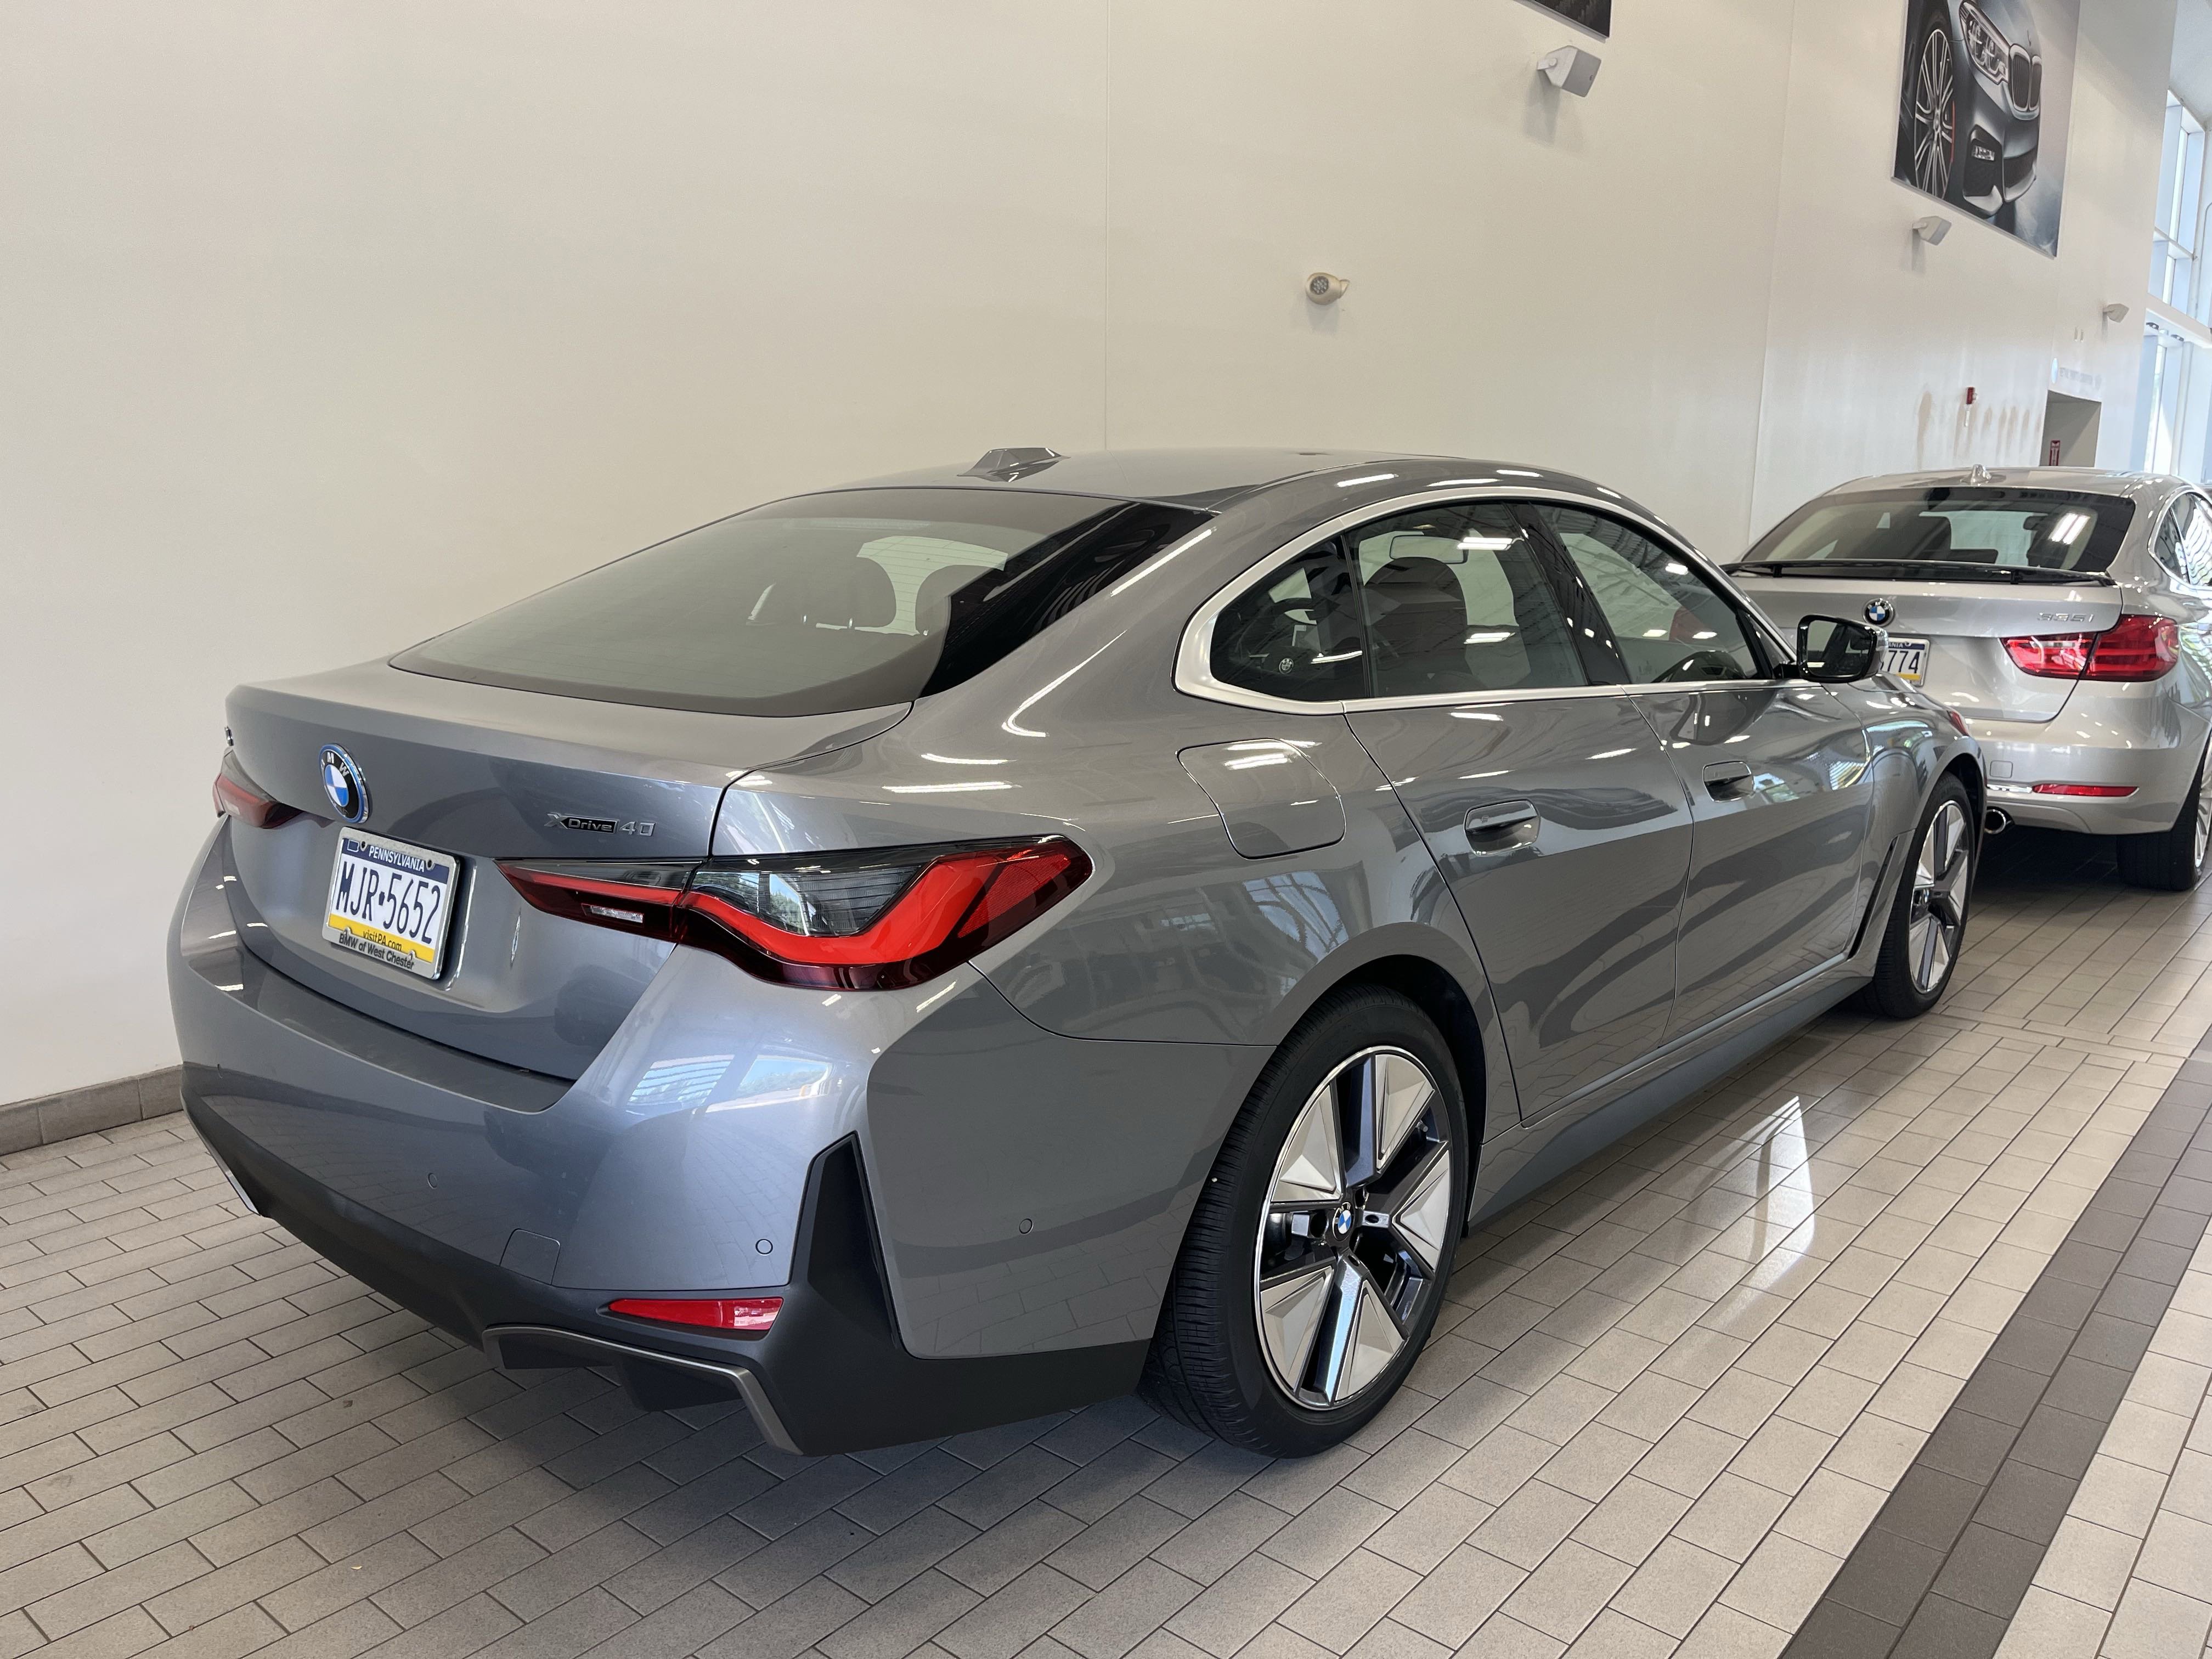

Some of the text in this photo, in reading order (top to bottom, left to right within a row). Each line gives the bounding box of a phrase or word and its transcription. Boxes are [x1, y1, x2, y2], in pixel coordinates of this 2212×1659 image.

[621, 821, 657, 837] 40
[369, 845, 425, 872] PENNSYLVANIA
[339, 933, 415, 969] BMW of West Chester
[363, 929, 402, 951] visitPA.com
